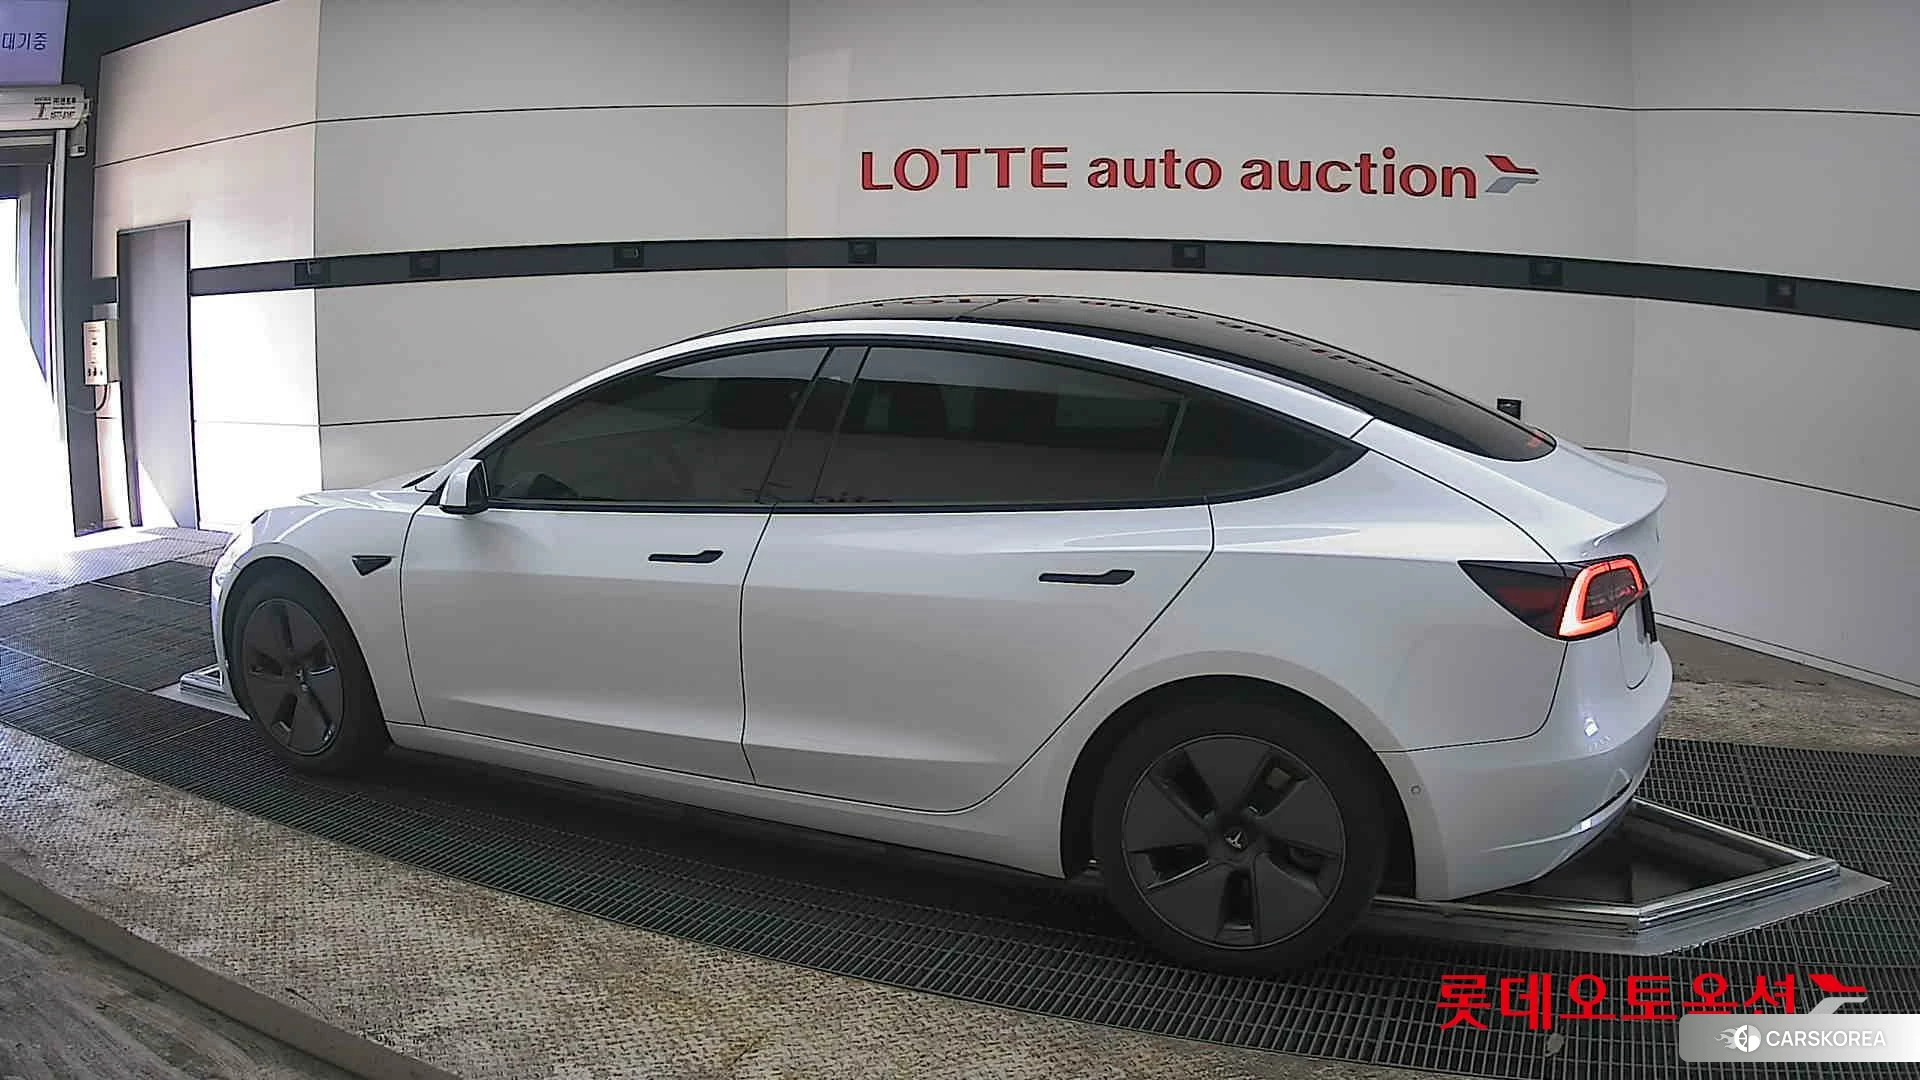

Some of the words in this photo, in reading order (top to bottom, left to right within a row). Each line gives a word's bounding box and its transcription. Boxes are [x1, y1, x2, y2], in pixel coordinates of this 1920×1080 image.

[2, 32, 48, 50] 대기중
[861, 147, 1067, 190] LOTTE
[1087, 149, 1222, 190] auto
[1240, 147, 1477, 199] auction
